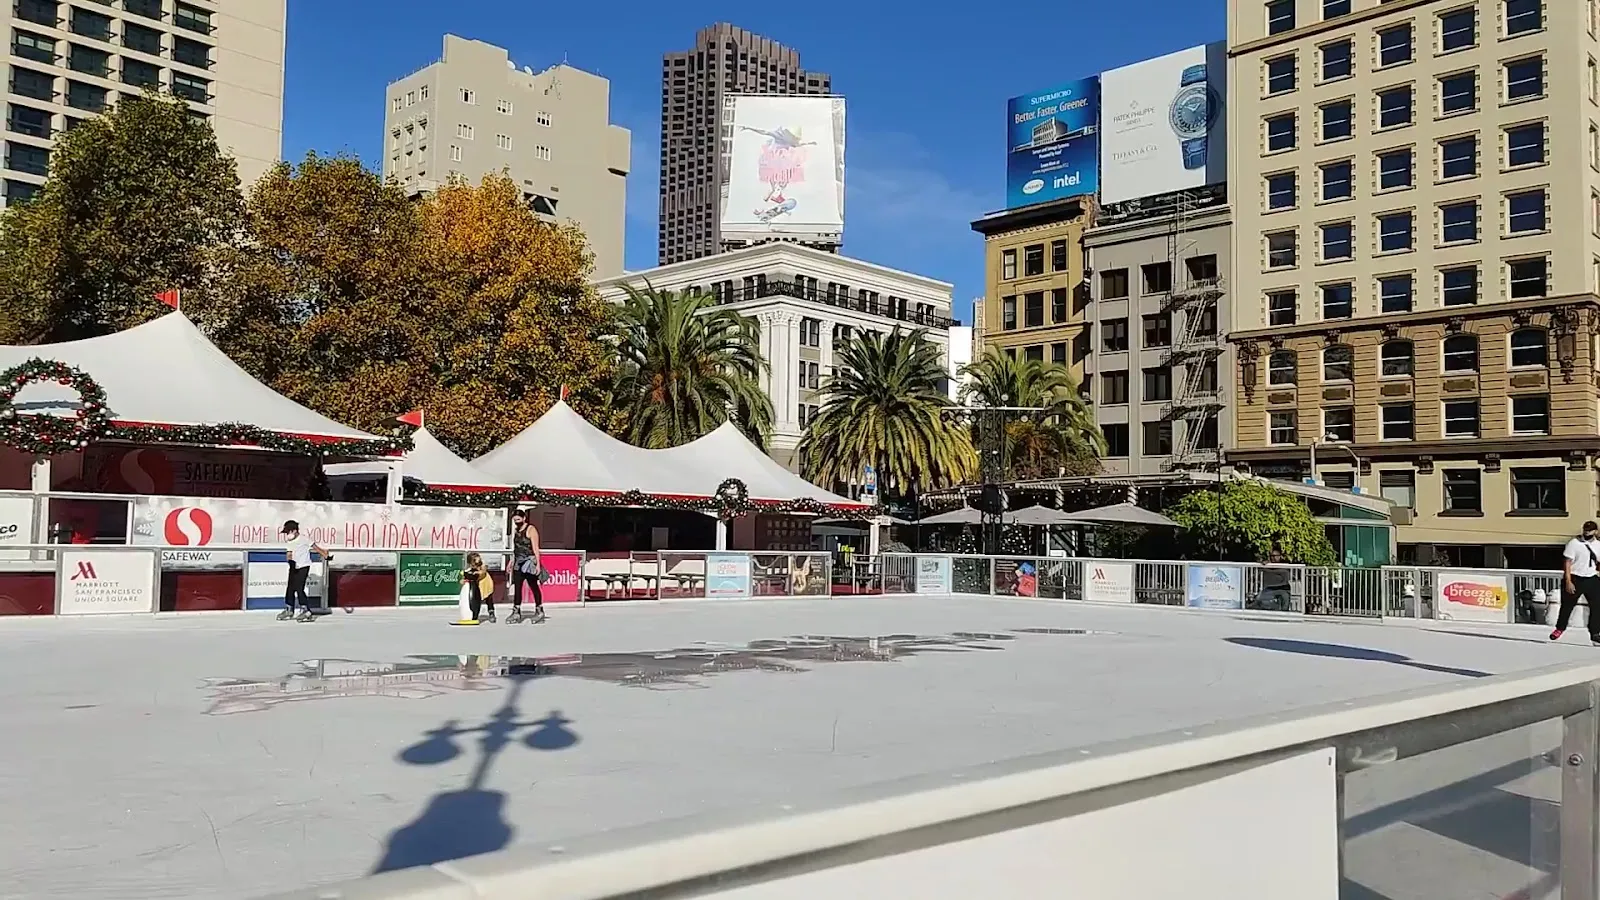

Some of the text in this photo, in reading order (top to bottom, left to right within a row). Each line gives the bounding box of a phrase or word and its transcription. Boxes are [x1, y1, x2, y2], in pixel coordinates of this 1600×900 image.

[1031, 90, 1072, 105] SUPERMICRO
[1015, 98, 1089, 124] Better. Faster. Greener.
[1053, 171, 1081, 189] intel
[185, 462, 252, 482] SAFEWAY
[233, 525, 269, 544] HOME
[307, 527, 337, 544] YOUR
[345, 522, 422, 549] HOLIDAY
[431, 526, 484, 549] MAGIC
[162, 552, 211, 561] SAFEWAY
[401, 569, 461, 588] John's Grill
[1450, 585, 1493, 597] breeze
